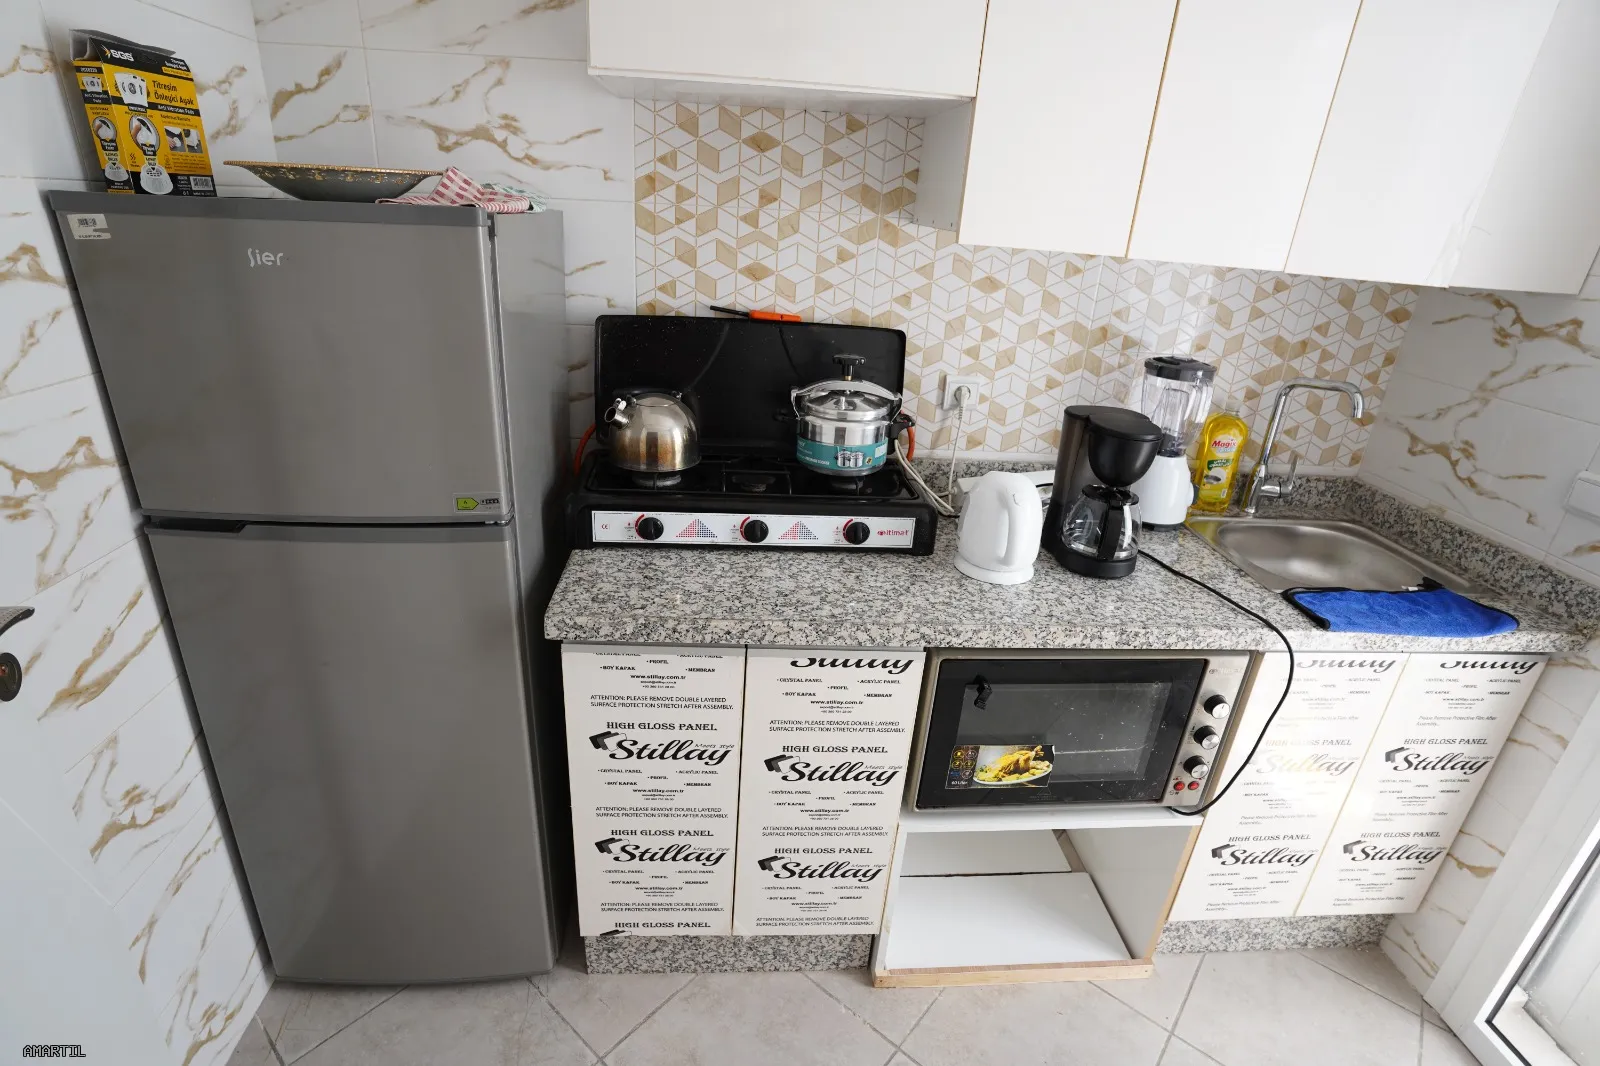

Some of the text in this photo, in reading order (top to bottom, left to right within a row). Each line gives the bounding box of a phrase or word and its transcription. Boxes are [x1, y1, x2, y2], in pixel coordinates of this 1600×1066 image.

[110, 49, 134, 62] SGS
[609, 740, 731, 766] Stillay
[1393, 753, 1490, 775] Stillay
[781, 762, 899, 786] Stillay
[613, 844, 727, 867] Stillay
[1220, 847, 1314, 867] Stillay
[1351, 844, 1443, 864] Stillay
[774, 861, 883, 883] Stillay
